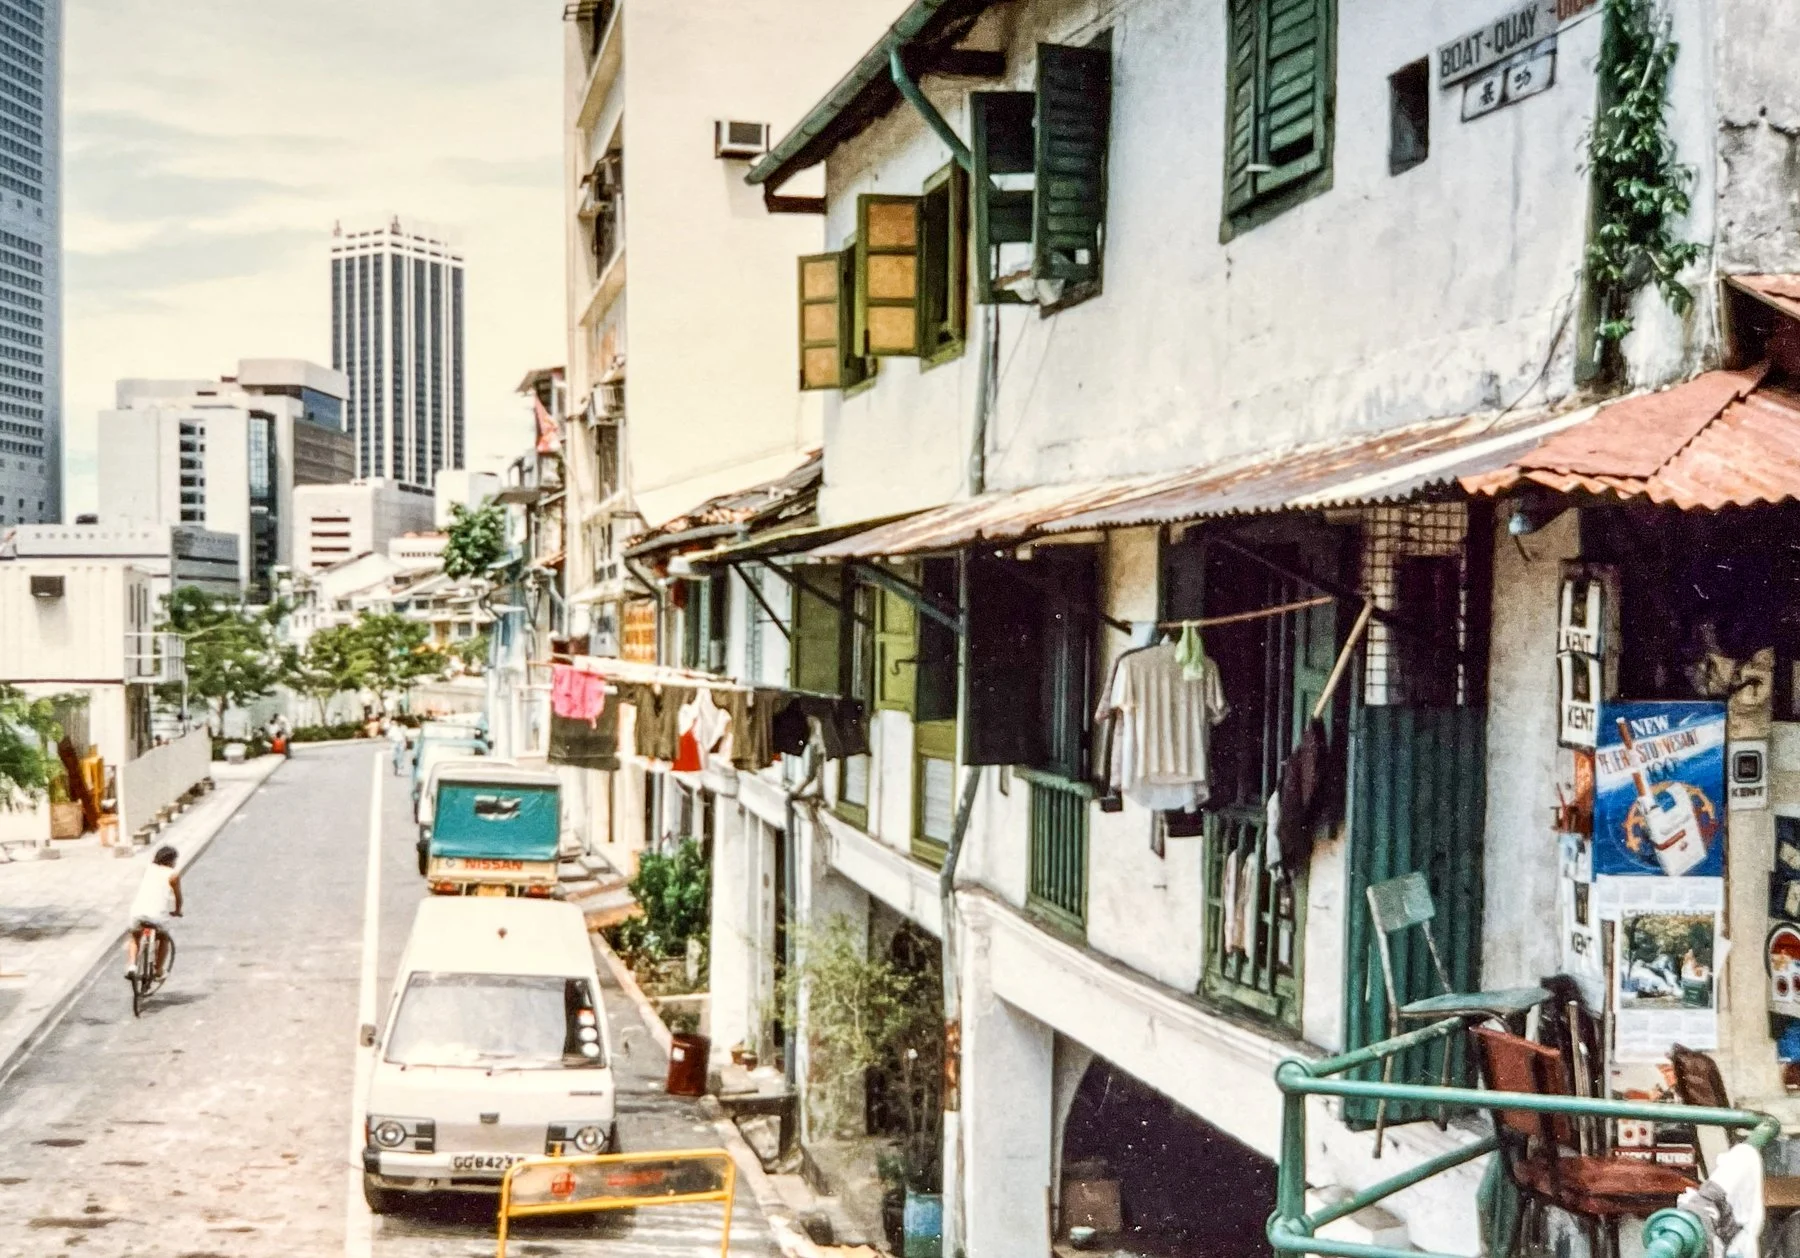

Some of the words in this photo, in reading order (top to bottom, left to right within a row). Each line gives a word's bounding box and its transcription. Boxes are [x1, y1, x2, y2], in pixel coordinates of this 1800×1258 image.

[1568, 705, 1595, 731] KENT
[1630, 714, 1669, 738] NEW
[463, 858, 524, 871] NISSAN
